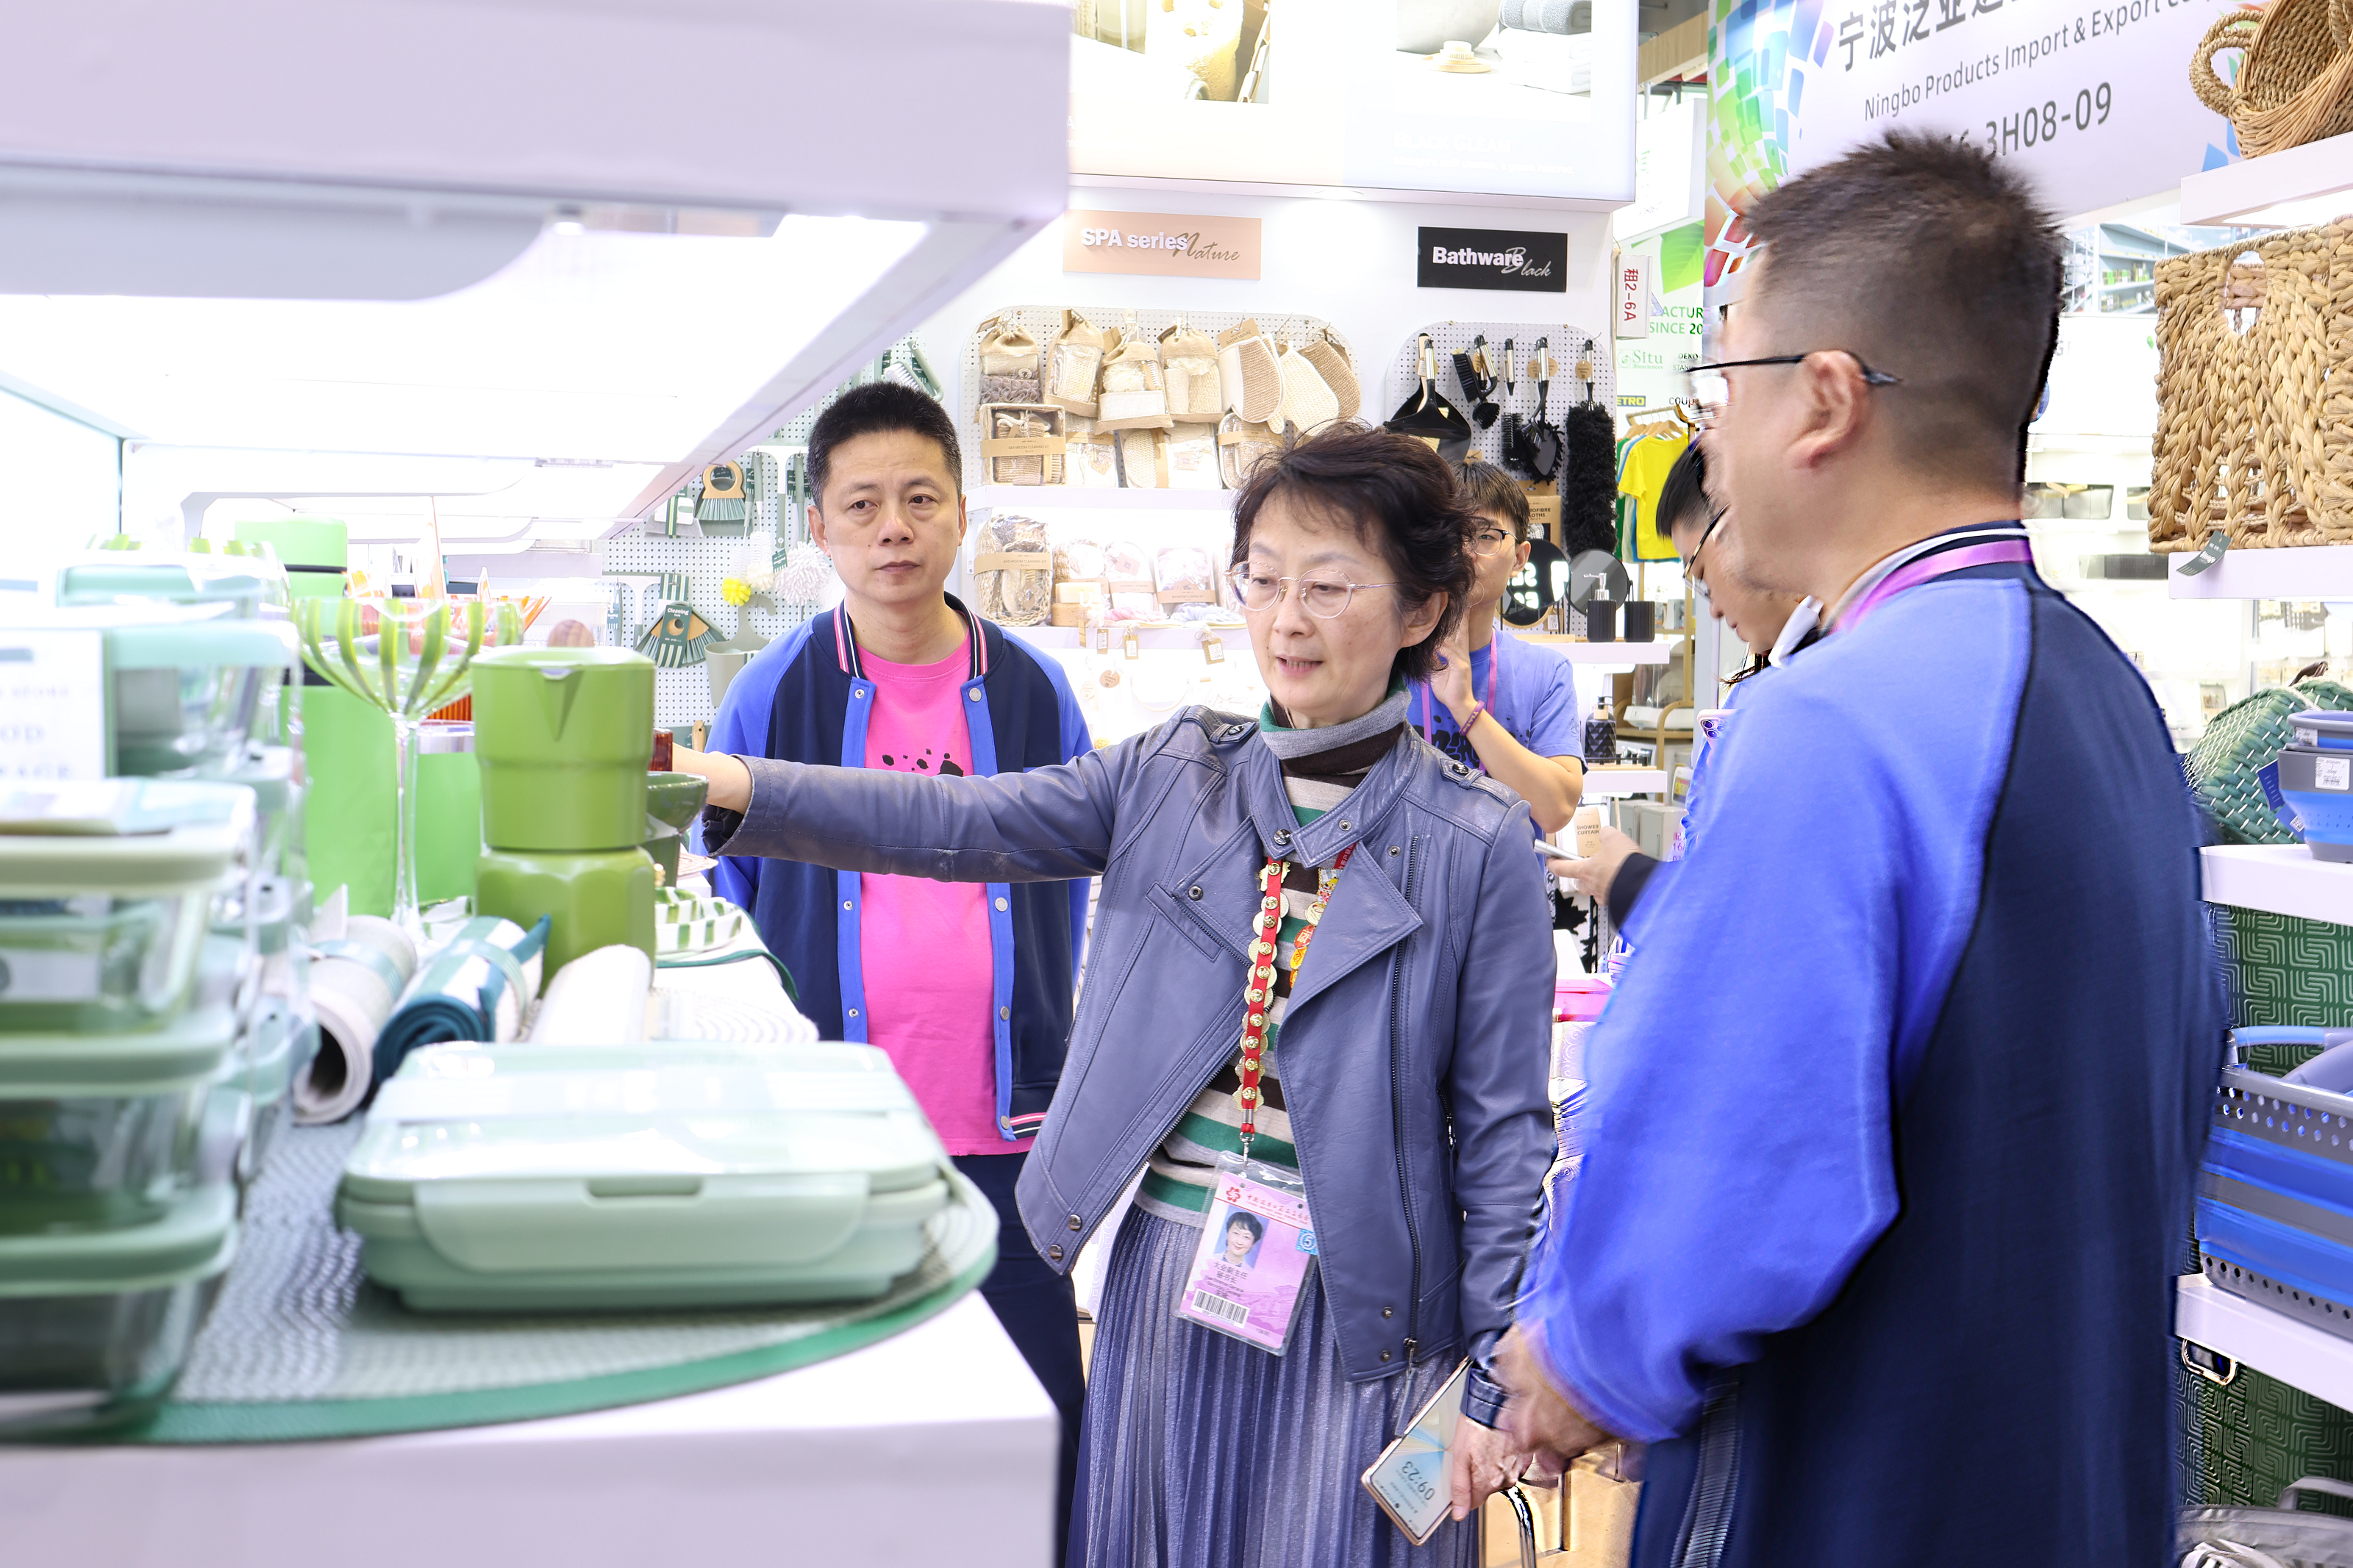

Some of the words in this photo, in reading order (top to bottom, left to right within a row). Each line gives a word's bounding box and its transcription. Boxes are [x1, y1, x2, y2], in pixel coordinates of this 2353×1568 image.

[1864, 82, 1921, 122] Ningbo
[1925, 54, 2000, 100] Products
[2004, 26, 2069, 71] Import
[2073, 22, 2087, 44] &
[2091, 0, 2160, 37] Export
[1978, 82, 2113, 162] 3H08-09
[1080, 228, 1123, 247] SPA
[1126, 232, 1188, 250] series
[1171, 232, 1240, 261] Nature
[1432, 246, 1524, 267] Bathware
[1501, 247, 1552, 276] Black
[1661, 306, 1704, 319] ACTUR
[1238, 330, 1252, 339] WARE
[1649, 322, 1685, 334] SINCE
[1689, 323, 1704, 334] 20
[1633, 350, 1663, 364] Situ
[1617, 397, 1645, 406] ETRO
[667, 607, 690, 616] Cleaning
[1402, 1461, 1435, 1500] 09:23
